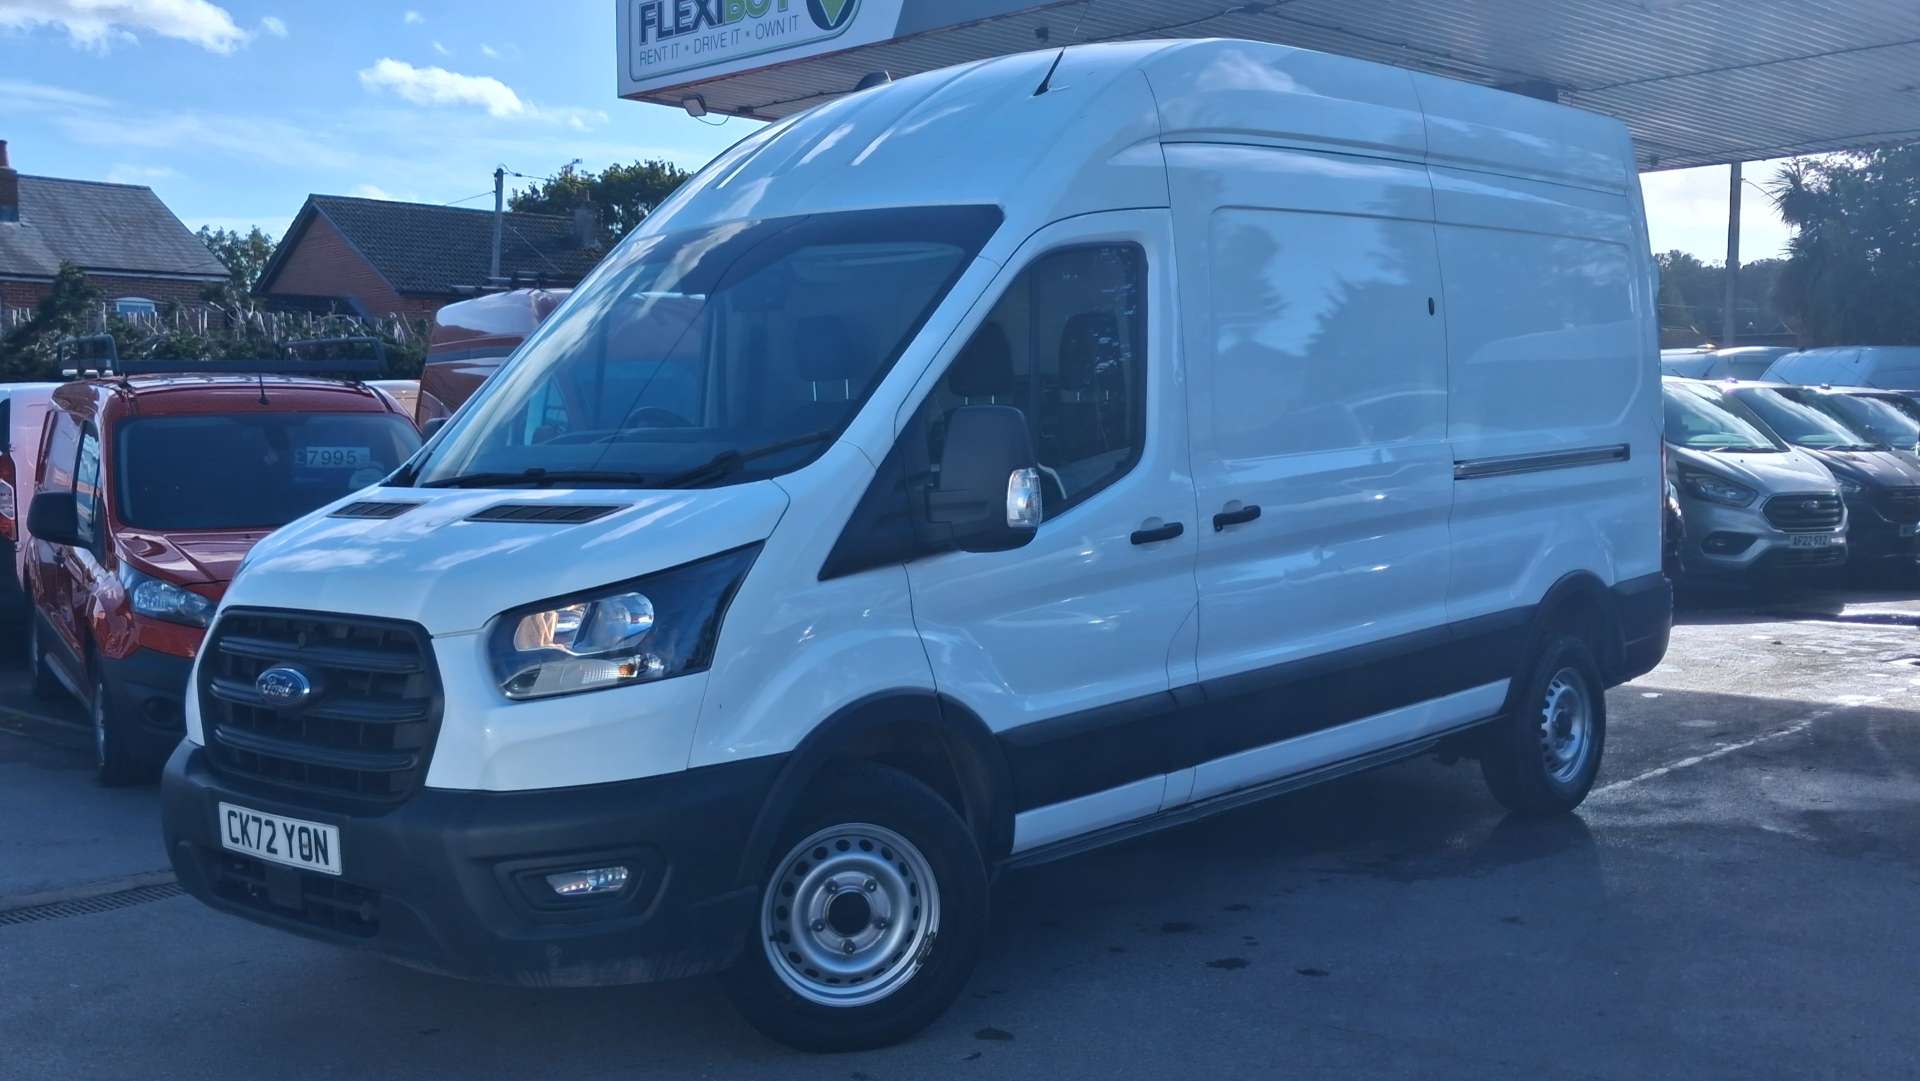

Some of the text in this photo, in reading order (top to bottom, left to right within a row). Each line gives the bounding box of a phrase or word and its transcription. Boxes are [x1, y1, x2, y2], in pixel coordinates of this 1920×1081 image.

[640, 15, 800, 66] RENT IT DRIVE IT OWN IT
[262, 673, 293, 697] Ford
[227, 810, 329, 866] CK72 YON
